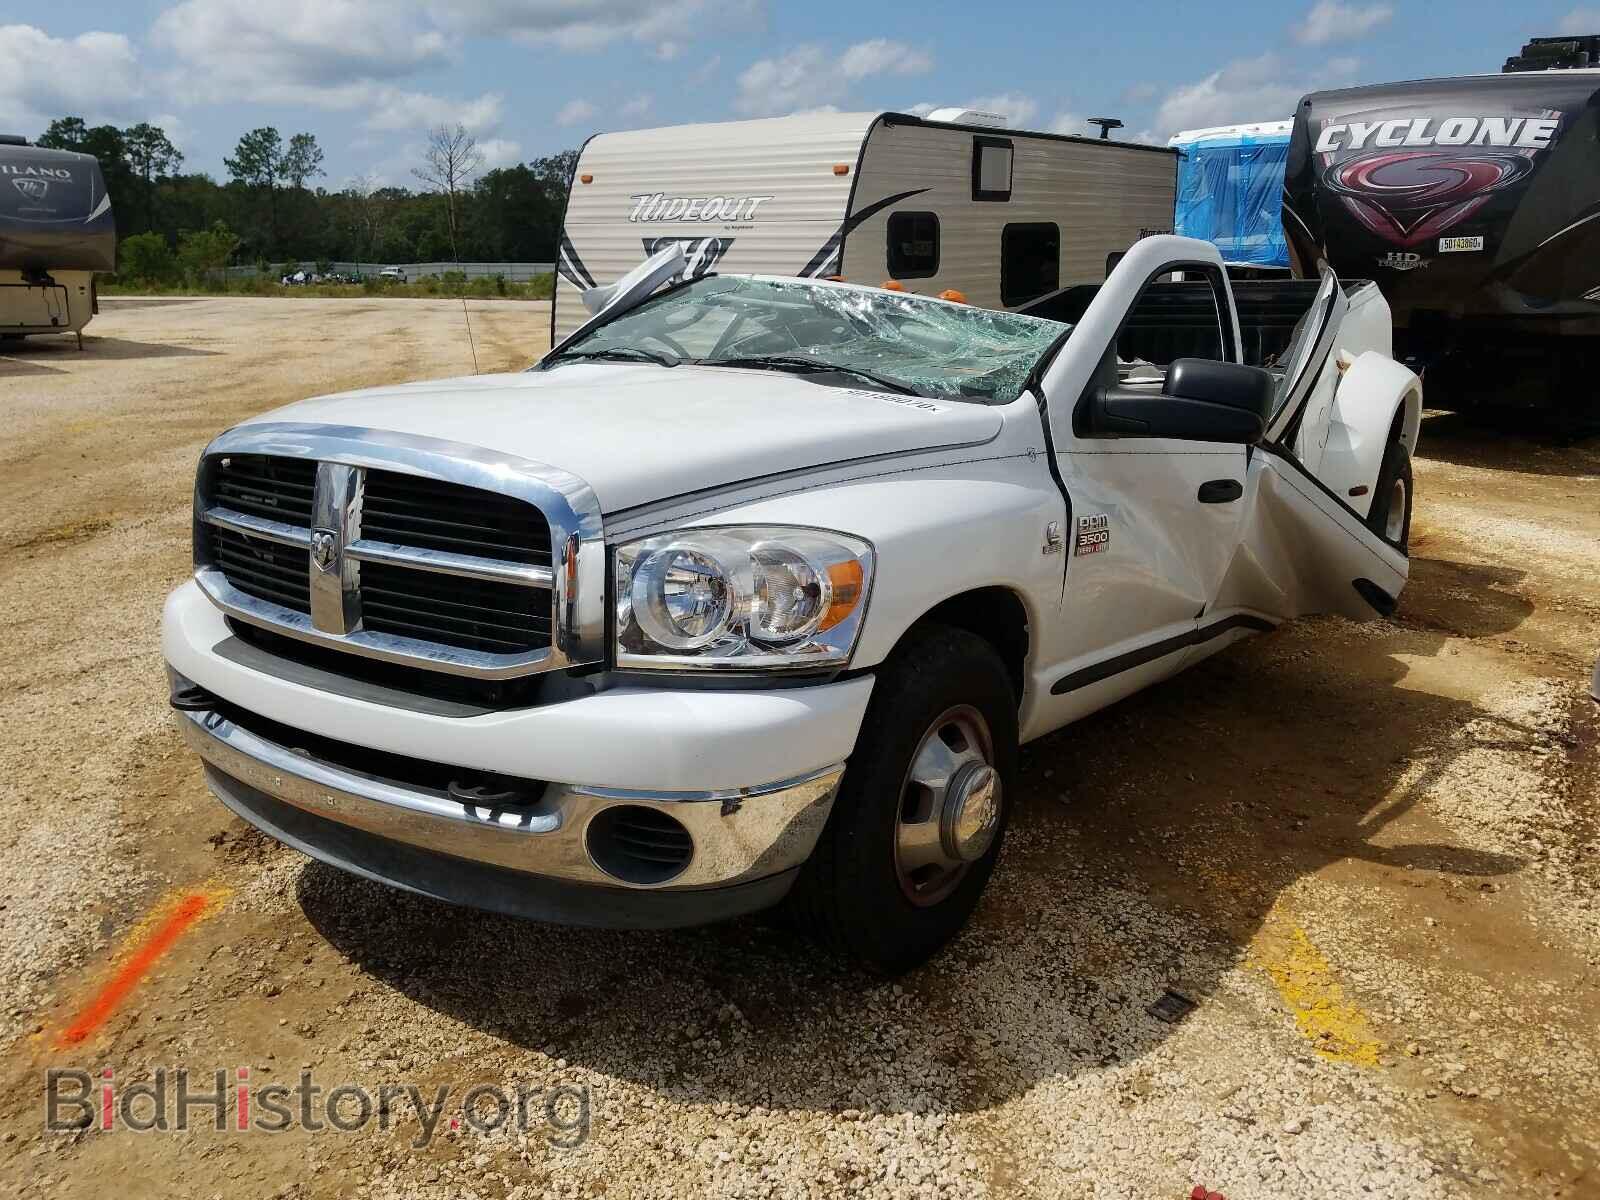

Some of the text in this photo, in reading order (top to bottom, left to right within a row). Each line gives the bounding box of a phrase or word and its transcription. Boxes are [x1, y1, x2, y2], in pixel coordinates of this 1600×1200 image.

[1315, 118, 1559, 152] CYCLONE
[629, 192, 775, 222] HIDEOUT
[1080, 532, 1107, 546] 3500
